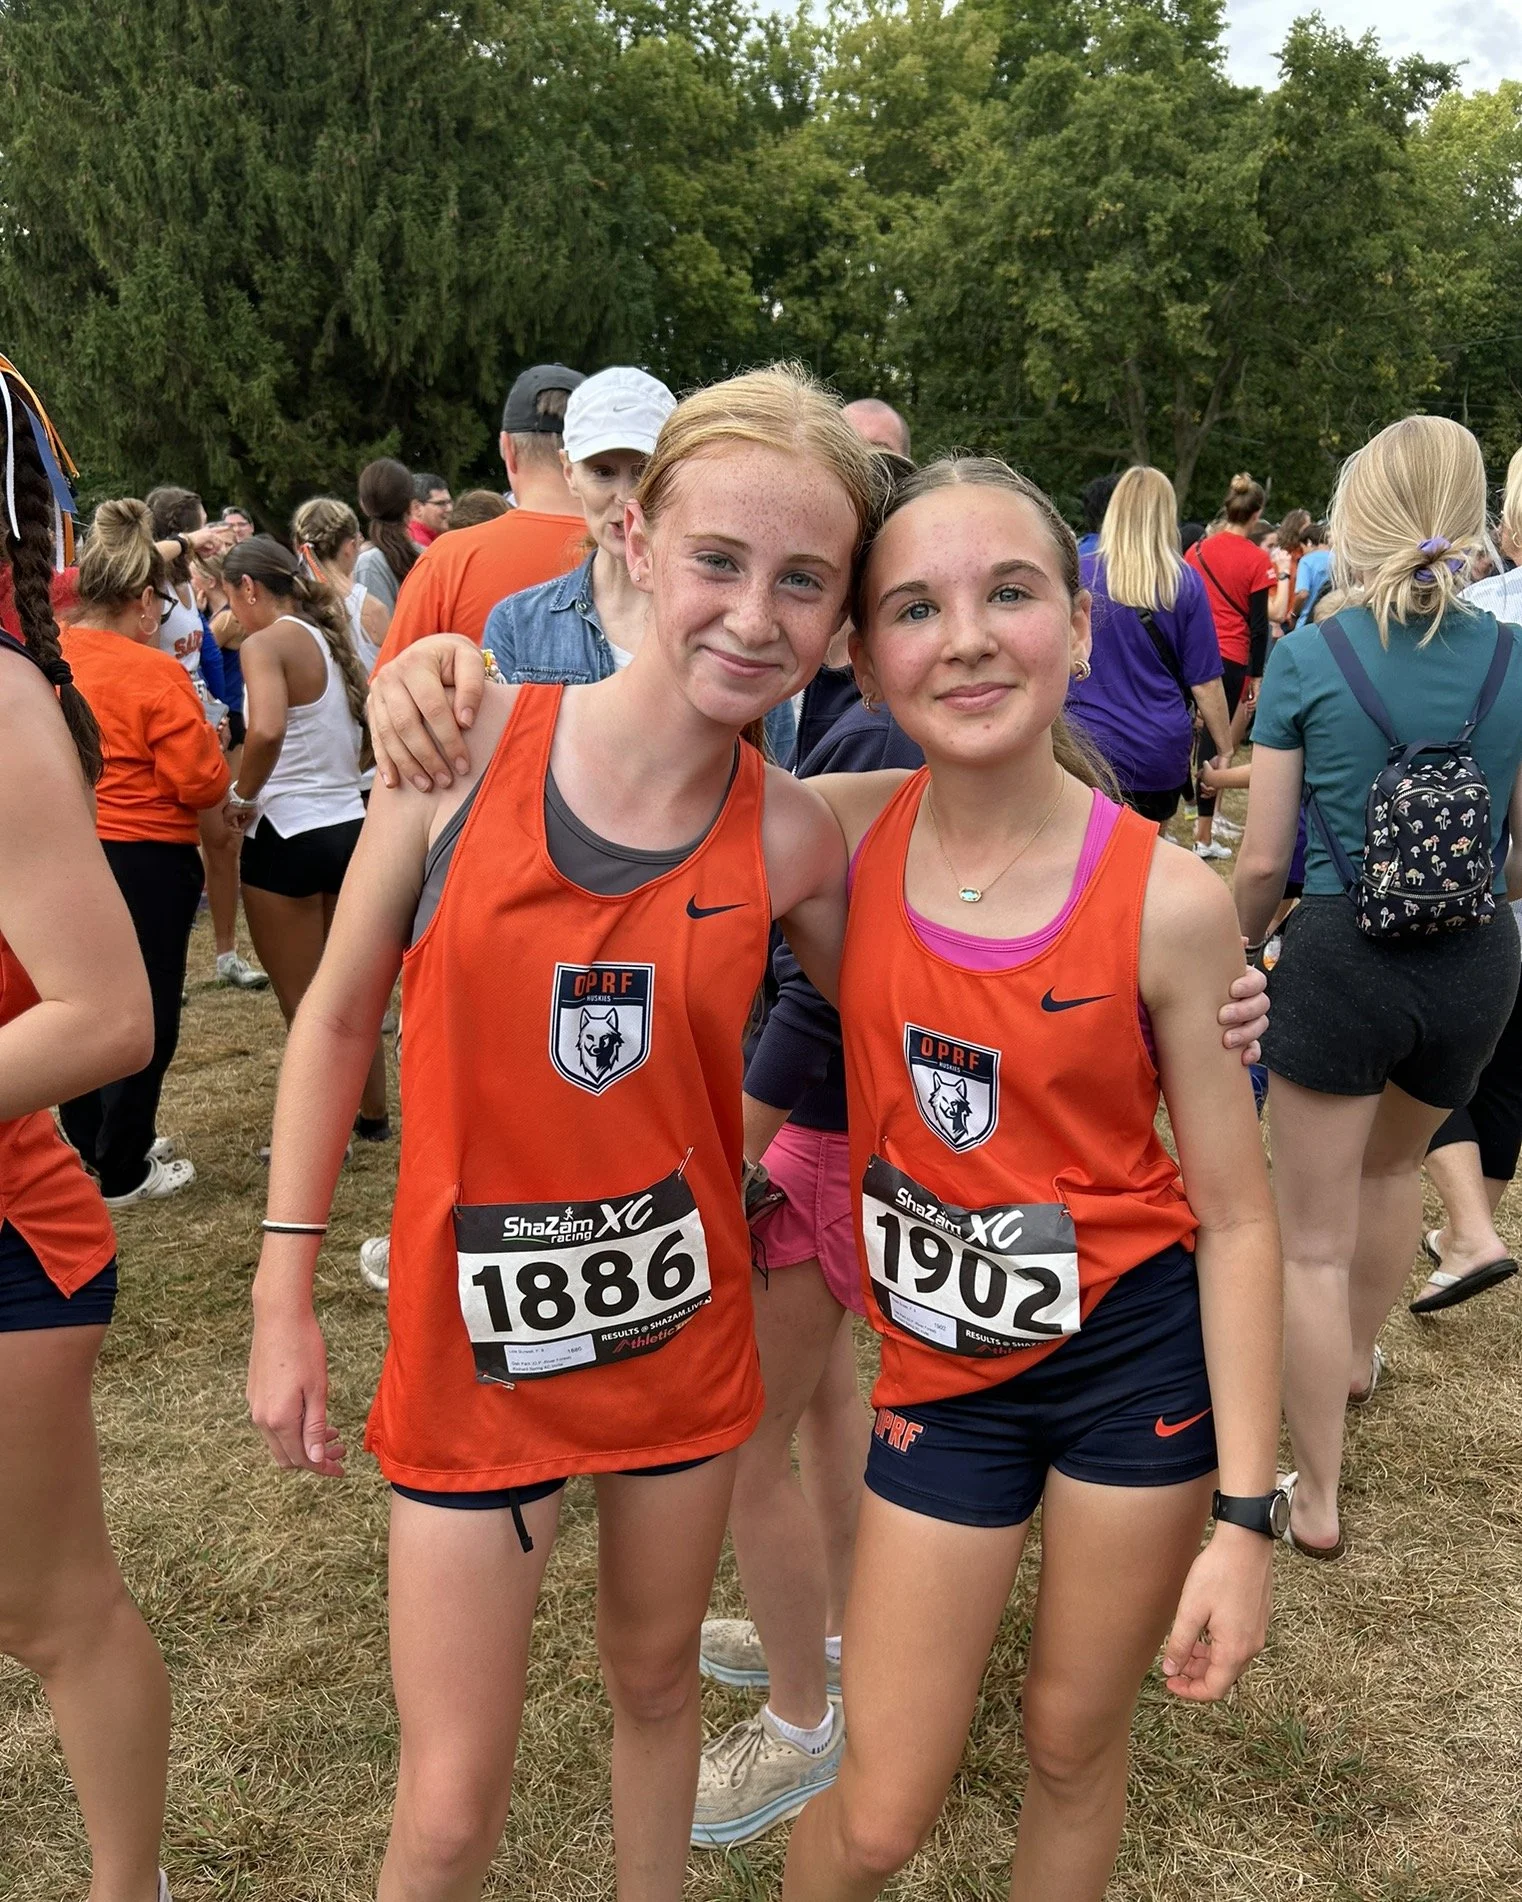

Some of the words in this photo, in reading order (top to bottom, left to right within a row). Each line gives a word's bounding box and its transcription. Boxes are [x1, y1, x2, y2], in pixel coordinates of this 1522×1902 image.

[574, 971, 633, 997] OPRF
[921, 1037, 980, 1070] OPRF
[502, 1214, 594, 1238] ShaZam
[595, 1193, 654, 1239] XC
[894, 1187, 962, 1237] ShaZam
[964, 1209, 1025, 1250] XC
[550, 1230, 593, 1244] racing
[471, 1228, 696, 1333] 1886
[876, 1211, 1064, 1335] 1902
[601, 1326, 640, 1342] RESULTS
[965, 1328, 1001, 1346] RESULTS
